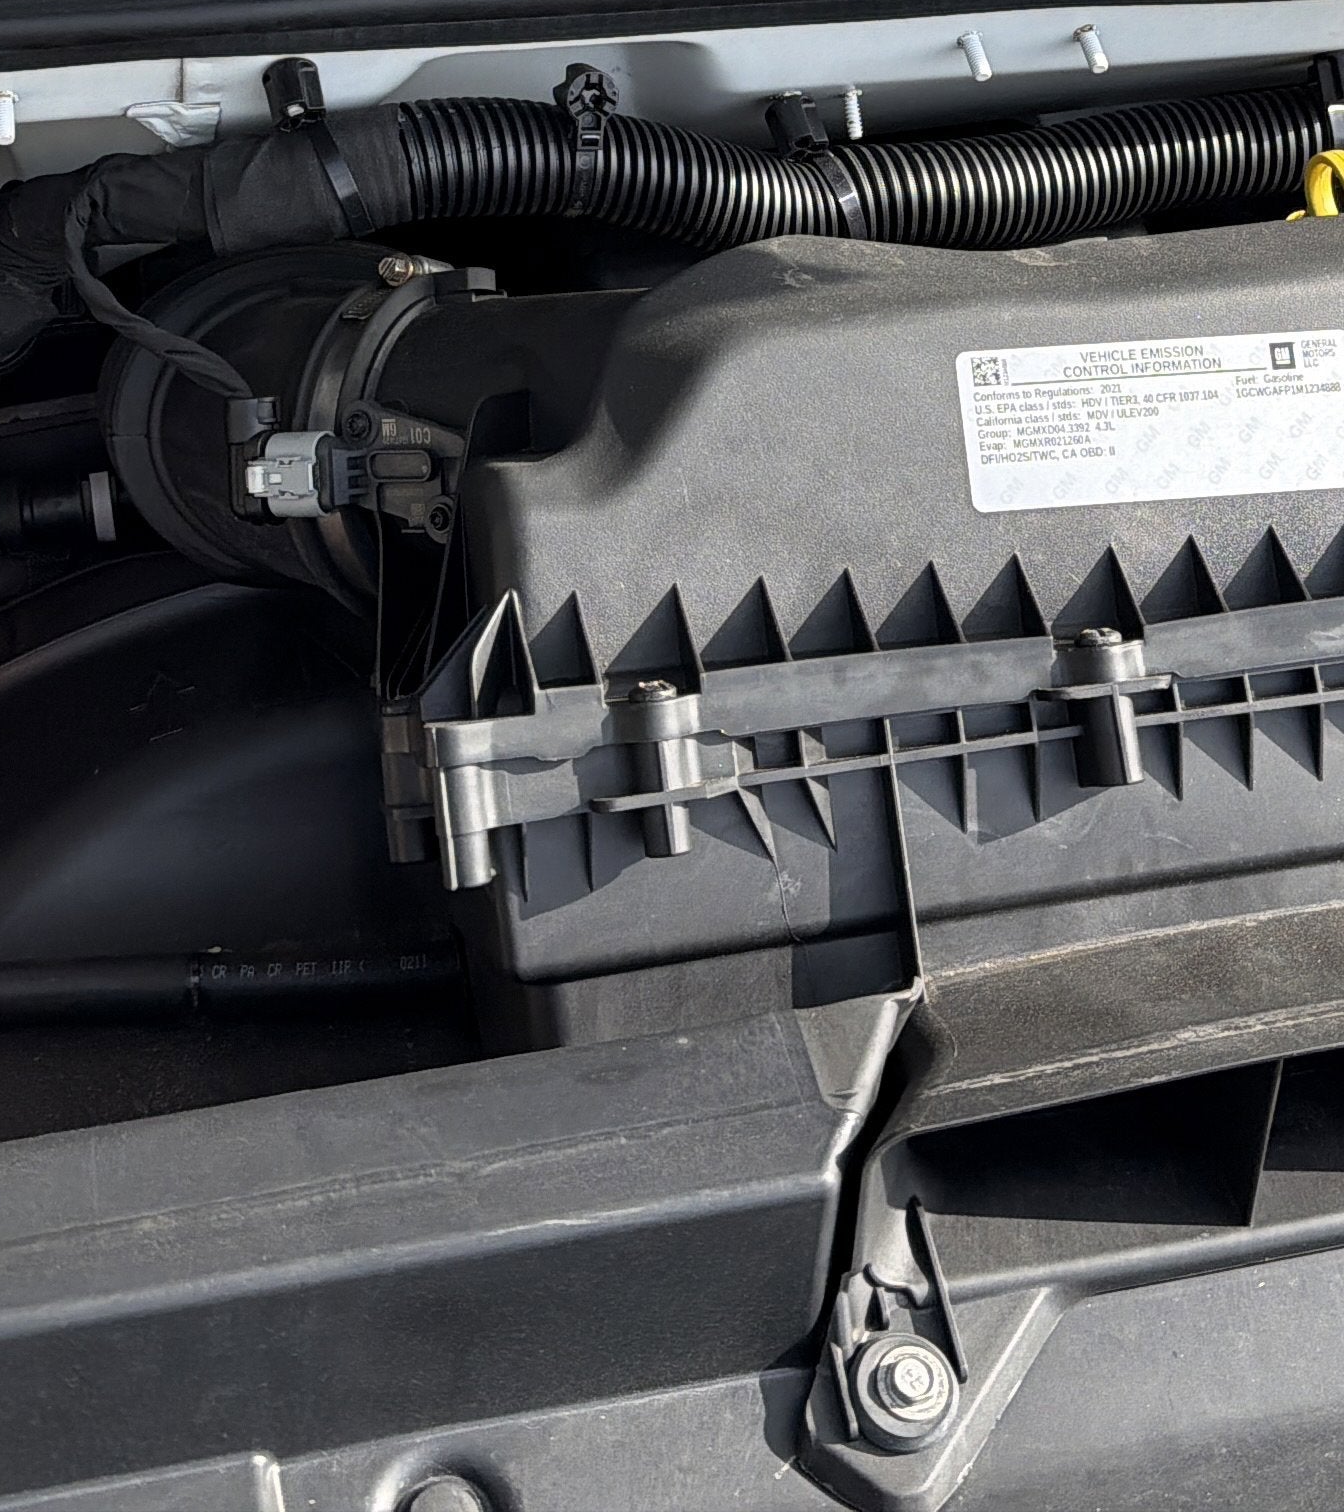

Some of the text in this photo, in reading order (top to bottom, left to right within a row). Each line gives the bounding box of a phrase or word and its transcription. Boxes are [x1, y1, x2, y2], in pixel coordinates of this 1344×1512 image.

[1301, 339, 1337, 349] GENERAL
[1080, 345, 1204, 363] VEHICLE EMISSION
[1063, 358, 1222, 378] CONTROL INFORMATION
[1264, 372, 1305, 383] Gasoline
[973, 384, 1122, 402] Conforms to Regulations: 2021
[997, 403, 1017, 414] EPA
[1019, 400, 1044, 412] class
[1052, 399, 1076, 411] stds:
[1081, 397, 1102, 408] HDV
[1143, 394, 1154, 404] 40
[1156, 392, 1177, 403] CFR
[976, 415, 1023, 428] California
[1025, 412, 1050, 424] class
[1057, 411, 1081, 422] stds:
[1087, 409, 1109, 420] MDV
[978, 427, 1011, 440] Group:
[979, 440, 1006, 453] Evap:
[1062, 448, 1078, 459] CA
[1080, 446, 1105, 457] OBD:
